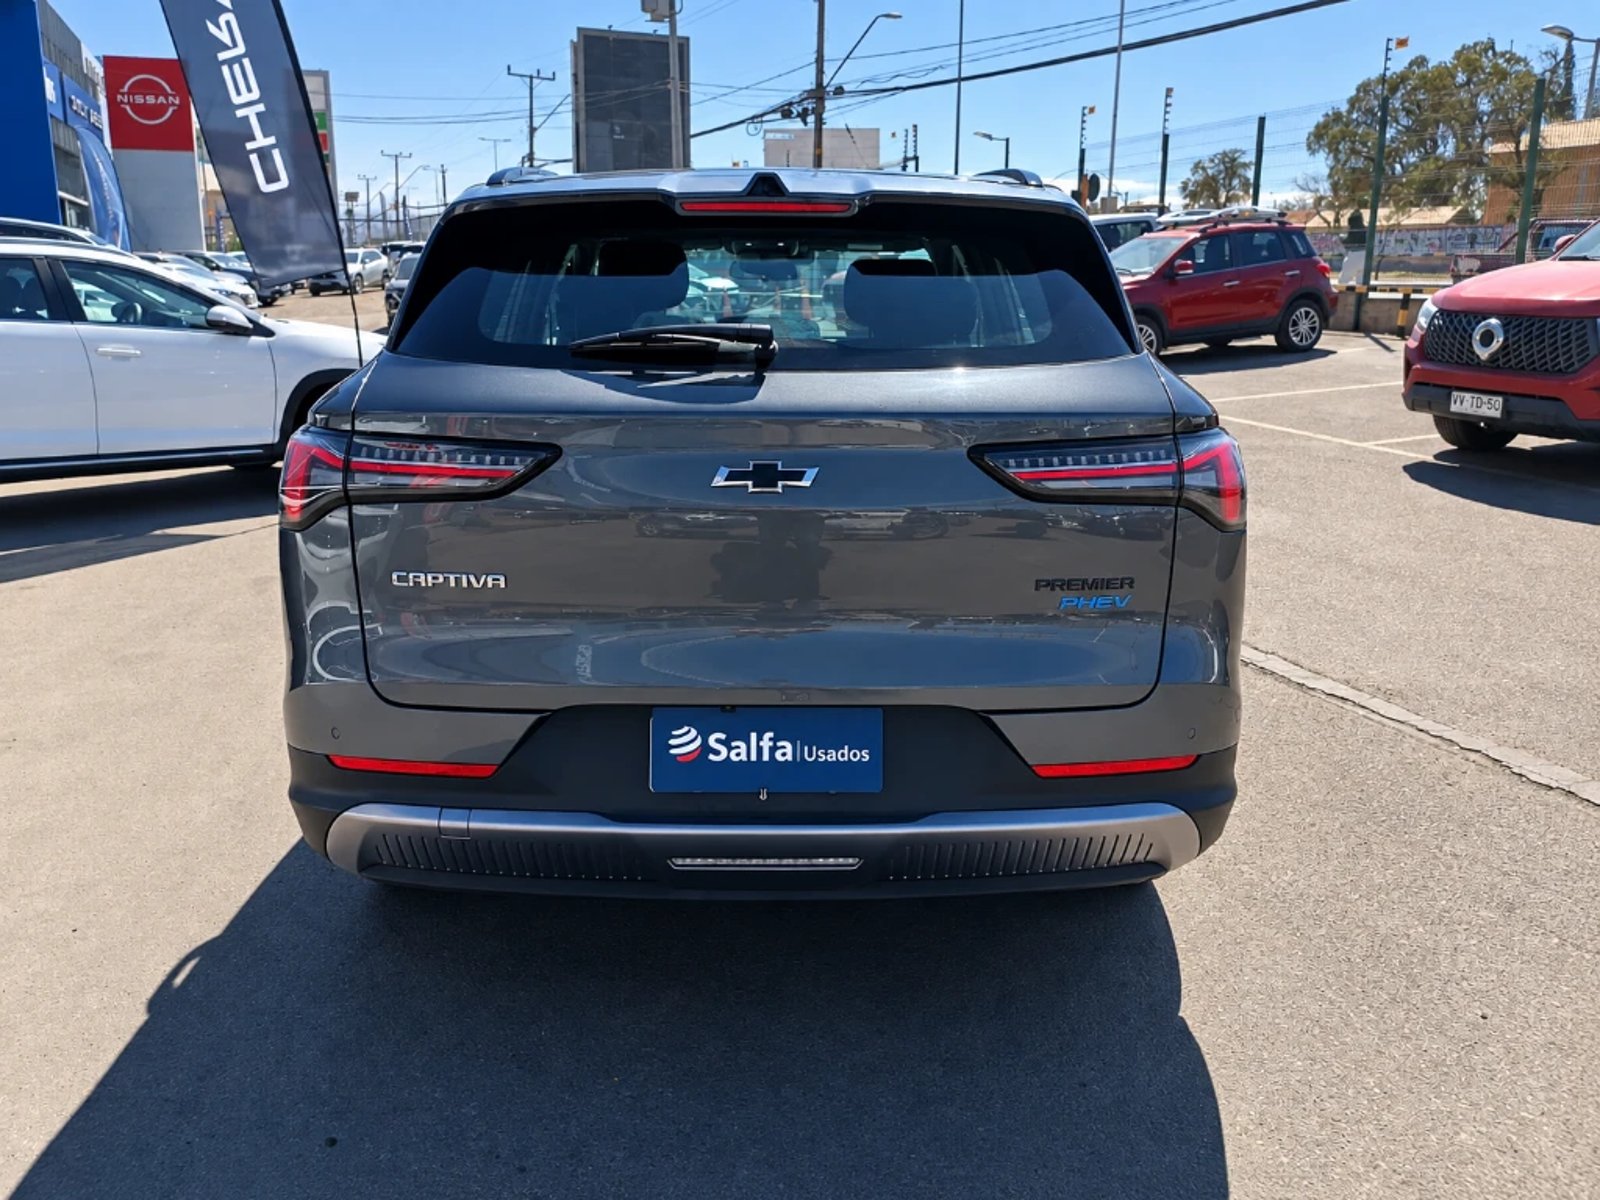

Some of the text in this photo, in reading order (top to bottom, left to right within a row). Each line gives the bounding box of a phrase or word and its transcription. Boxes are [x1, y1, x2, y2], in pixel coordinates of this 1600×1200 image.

[116, 94, 180, 105] NISSAN
[391, 571, 506, 589] CAPTIVA
[1034, 576, 1135, 592] PREMIER
[1059, 594, 1133, 610] PHEV
[707, 731, 870, 762] Salfa Usados
